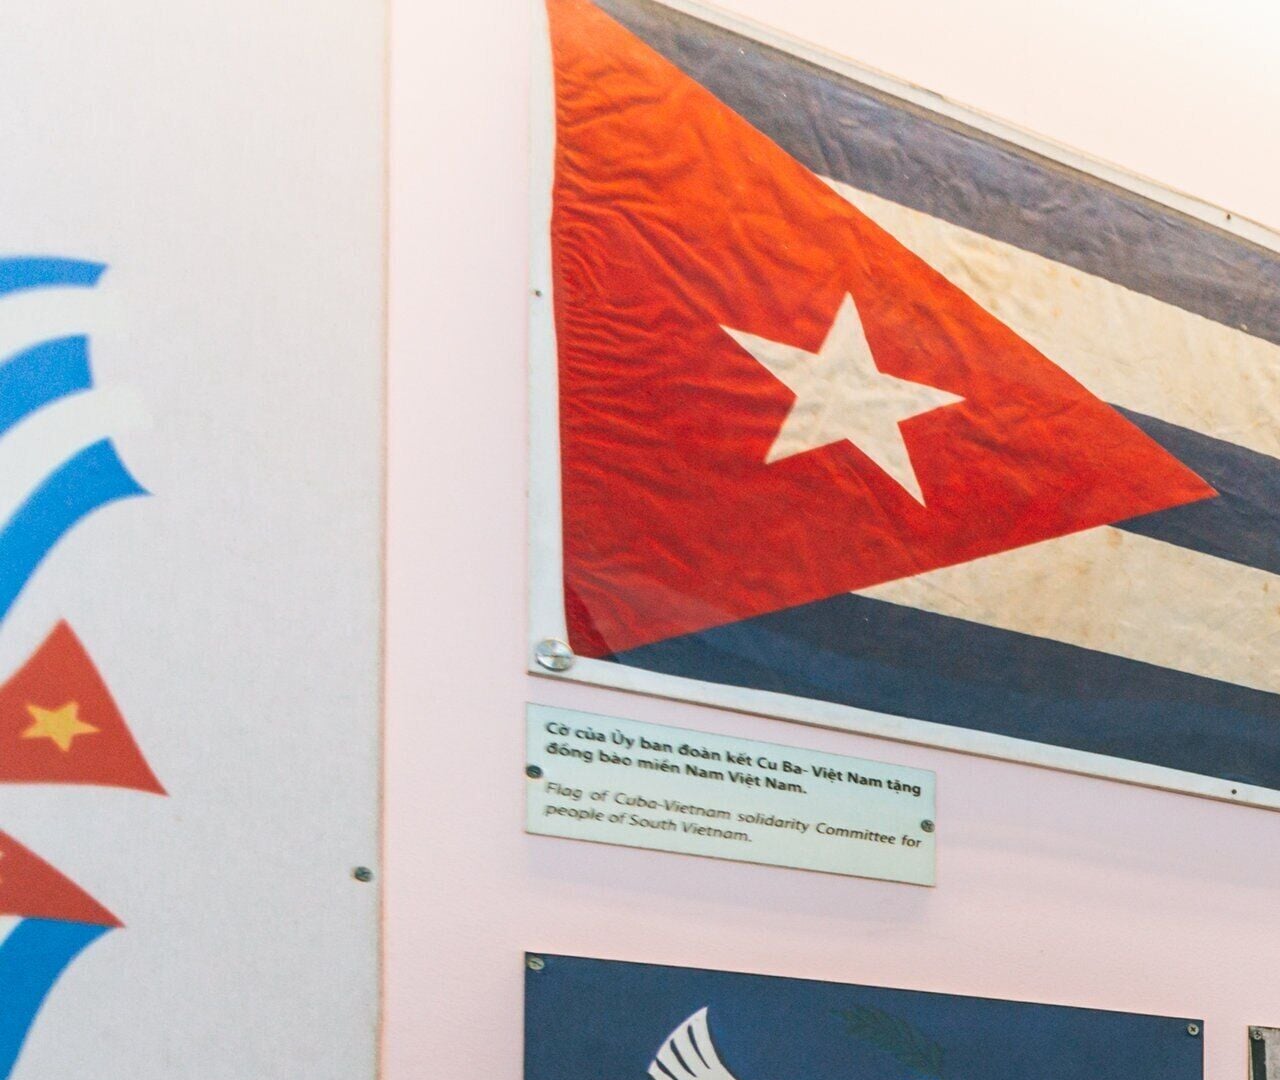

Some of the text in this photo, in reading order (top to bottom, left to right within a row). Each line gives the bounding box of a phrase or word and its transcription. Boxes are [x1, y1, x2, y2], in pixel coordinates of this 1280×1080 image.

[546, 722, 570, 736] Cờ
[575, 726, 606, 743] của
[640, 736, 673, 754] ban
[678, 743, 721, 762] đoàn
[726, 751, 752, 767] kết
[757, 756, 777, 771] Cu
[812, 765, 843, 784] Việt
[848, 772, 882, 789] Nam
[887, 779, 921, 797] tặng
[599, 750, 633, 767] bào
[685, 763, 724, 781] Nam
[728, 771, 761, 789] Việt
[765, 776, 808, 794] Nam.
[545, 804, 753, 842] people of South Vietnam.
[546, 782, 922, 849] Flag of Cuba-Vietnam solidarity Committee for
